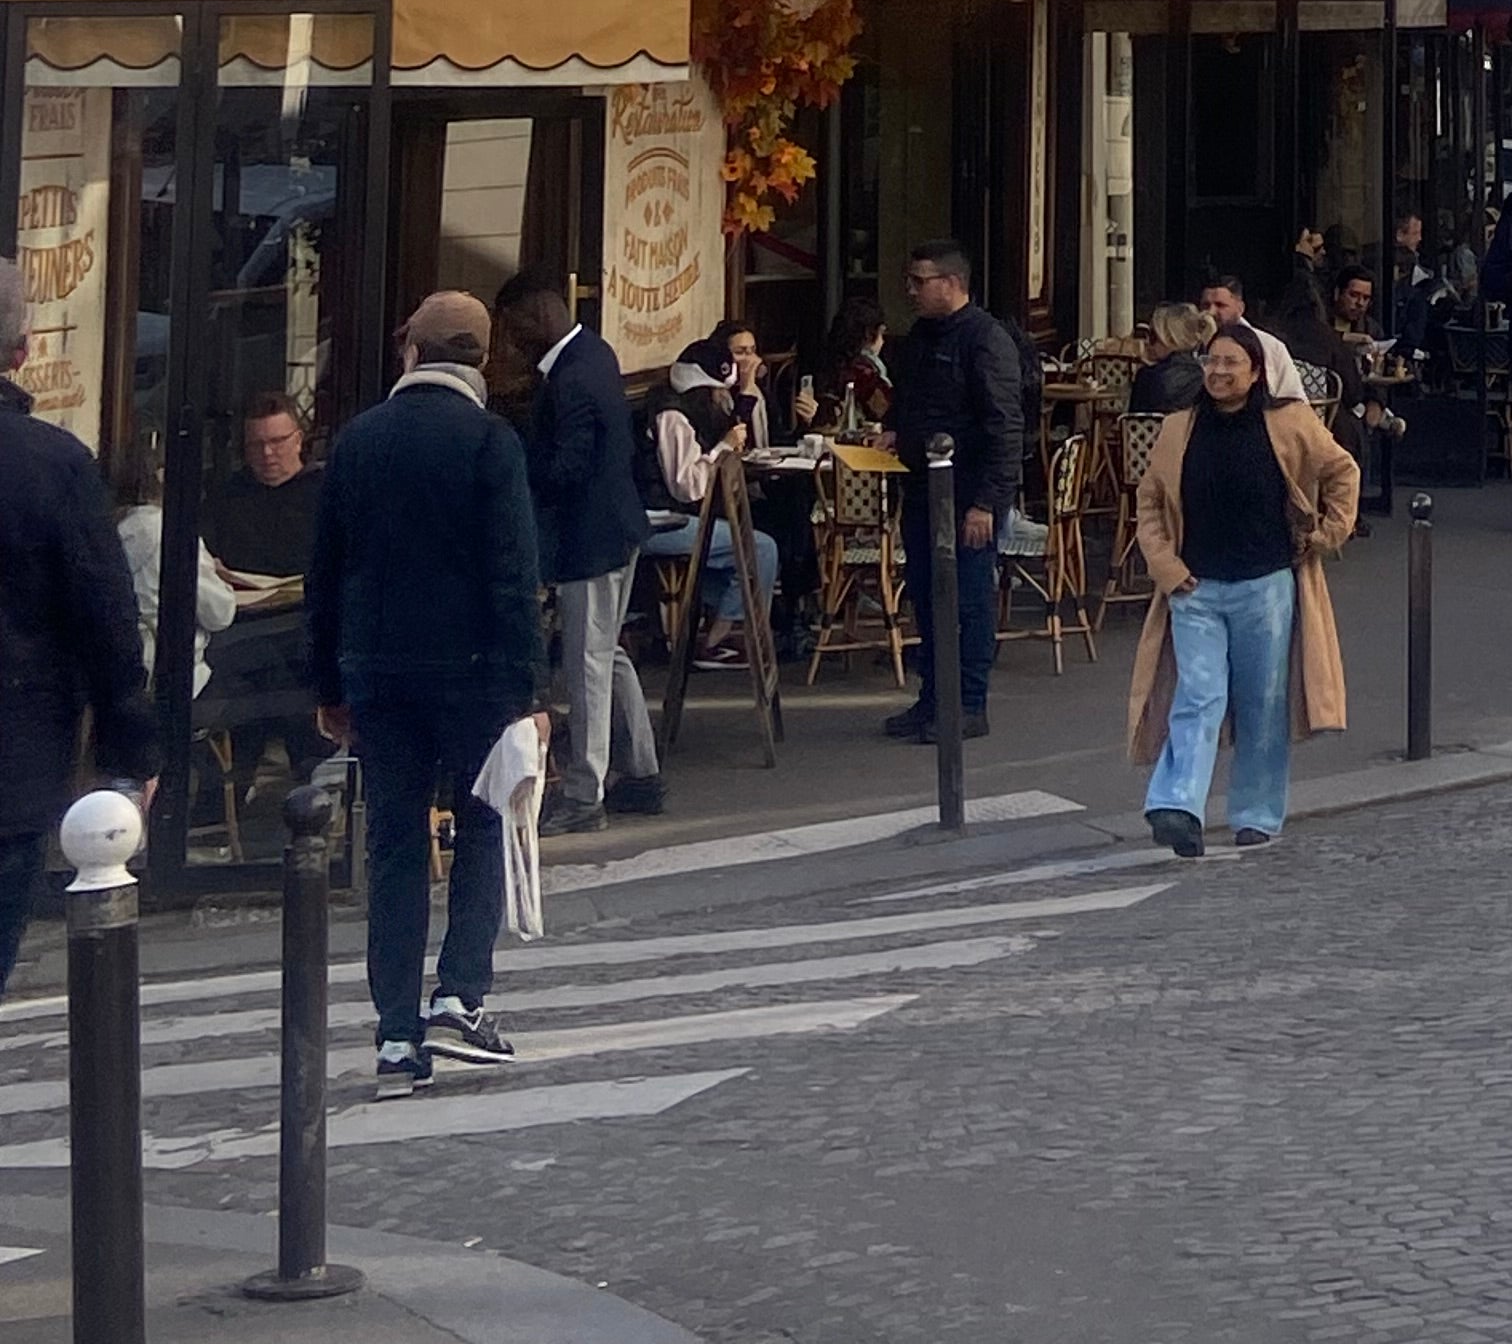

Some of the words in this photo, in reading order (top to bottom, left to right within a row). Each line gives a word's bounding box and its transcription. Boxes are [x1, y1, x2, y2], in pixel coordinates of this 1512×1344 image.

[28, 102, 76, 132] FRAIS
[18, 185, 79, 231] PETITS
[619, 273, 661, 313] TOUTE
